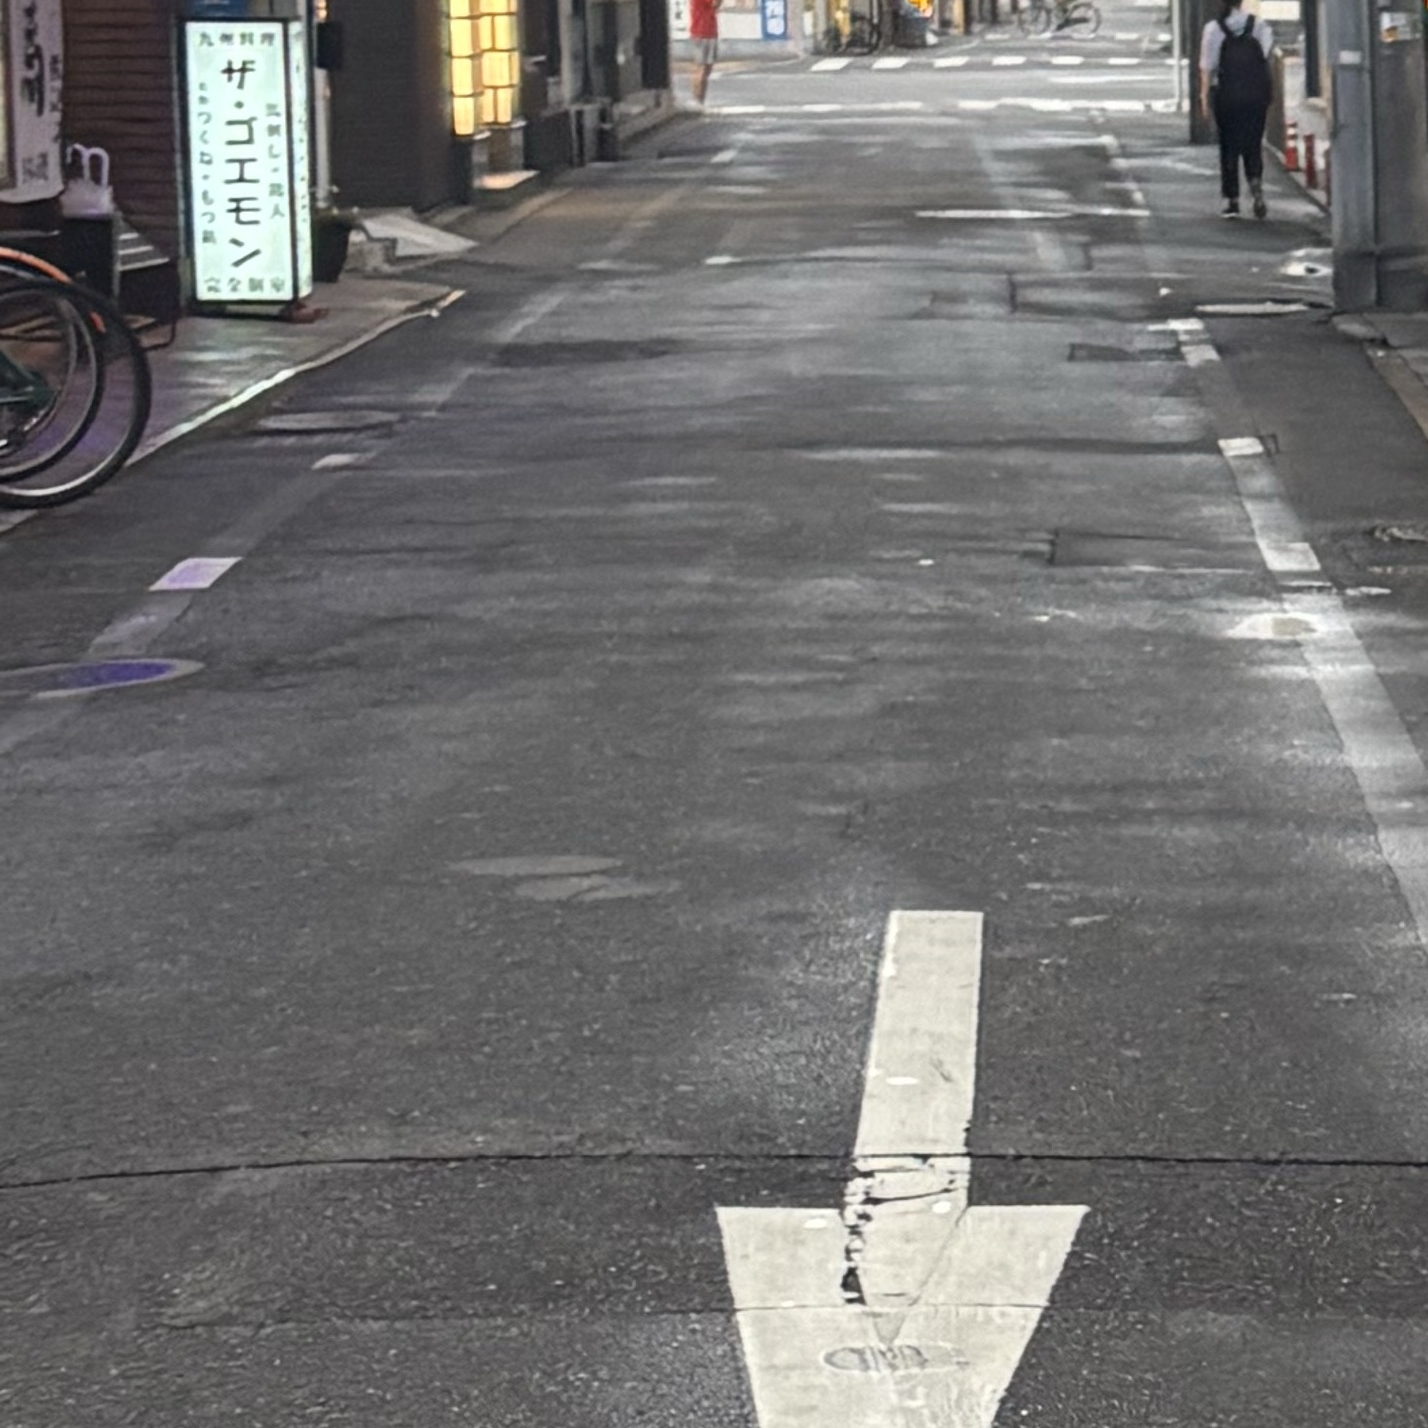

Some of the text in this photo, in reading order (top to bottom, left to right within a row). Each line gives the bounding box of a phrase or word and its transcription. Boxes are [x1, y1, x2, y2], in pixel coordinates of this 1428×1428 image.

[220, 59, 261, 267] ザ・ゴエモン
